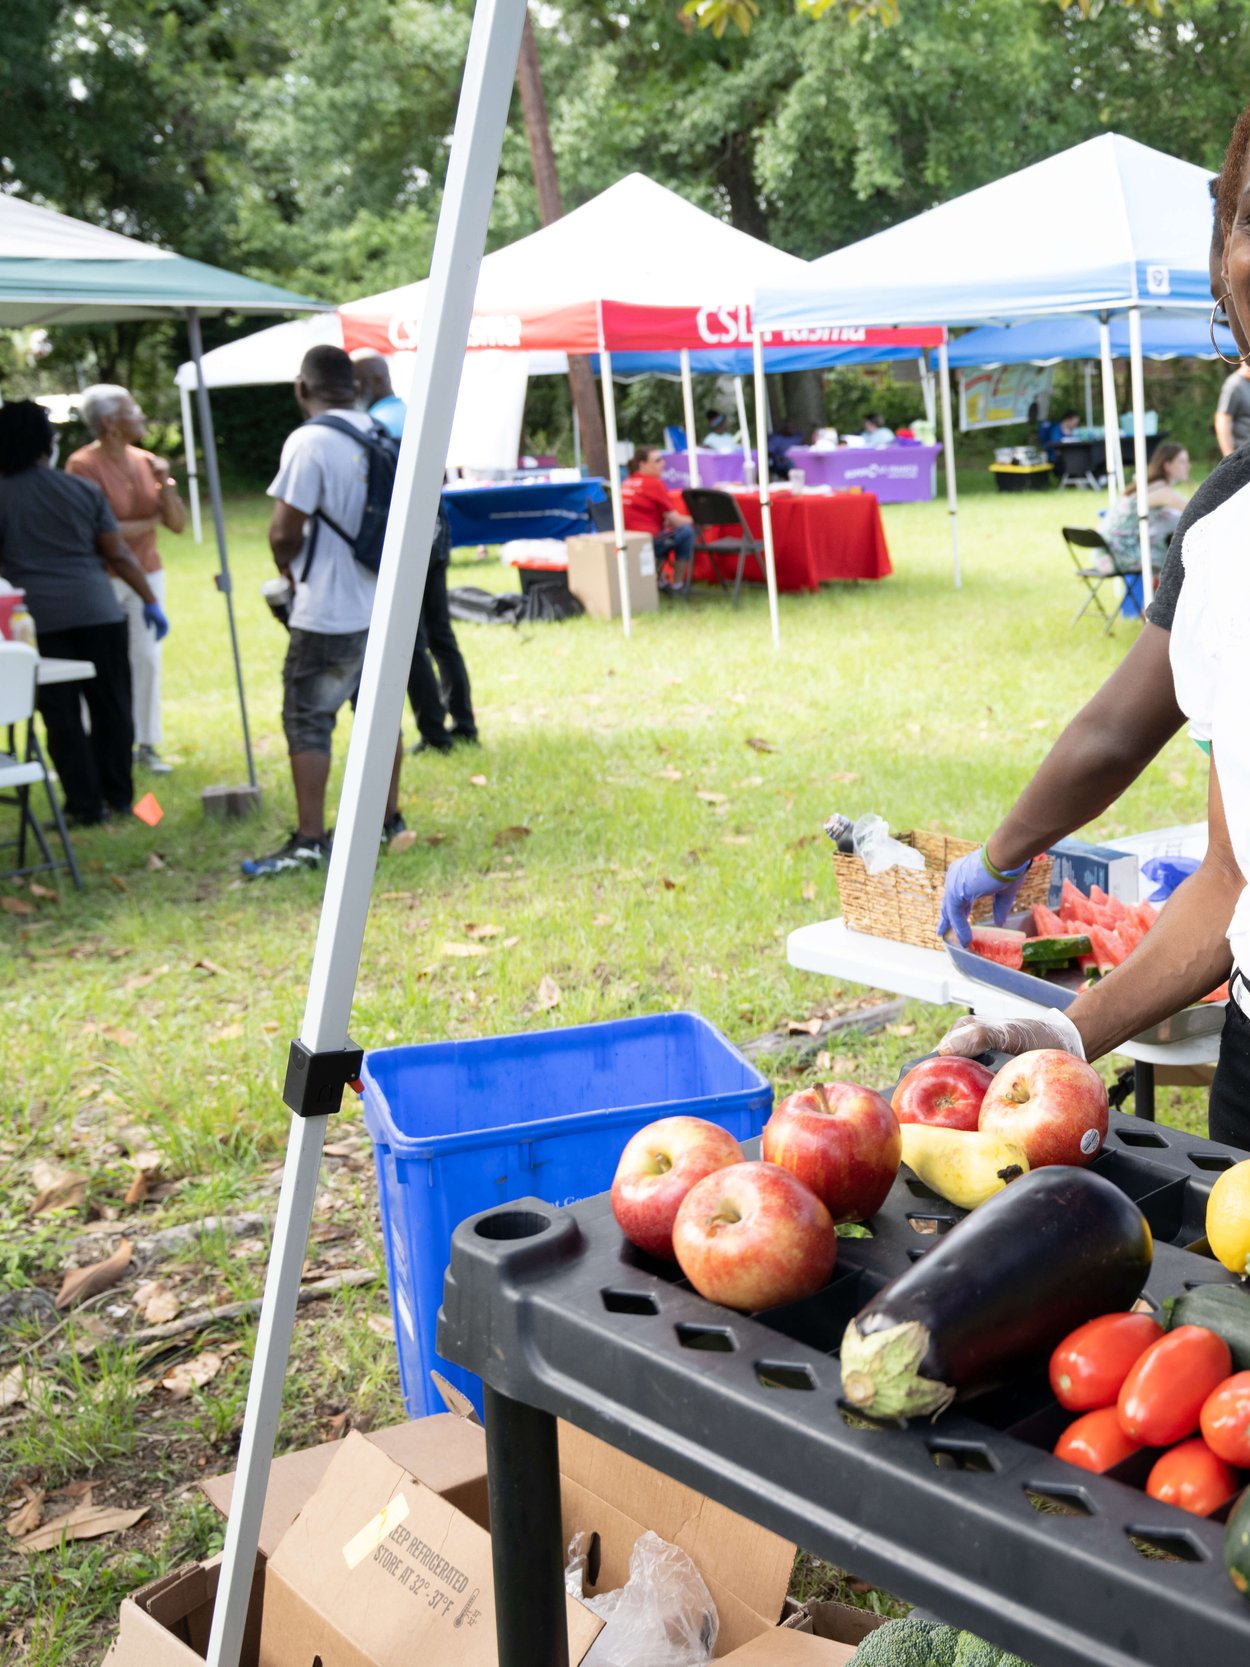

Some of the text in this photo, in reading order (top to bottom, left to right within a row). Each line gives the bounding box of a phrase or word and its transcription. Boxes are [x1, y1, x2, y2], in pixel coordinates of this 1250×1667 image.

[388, 312, 418, 350] CS
[696, 304, 754, 344] CSL
[373, 1544, 404, 1577] STORE
[398, 1565, 415, 1586] AT
[406, 1537, 469, 1594] REFRIGERATED
